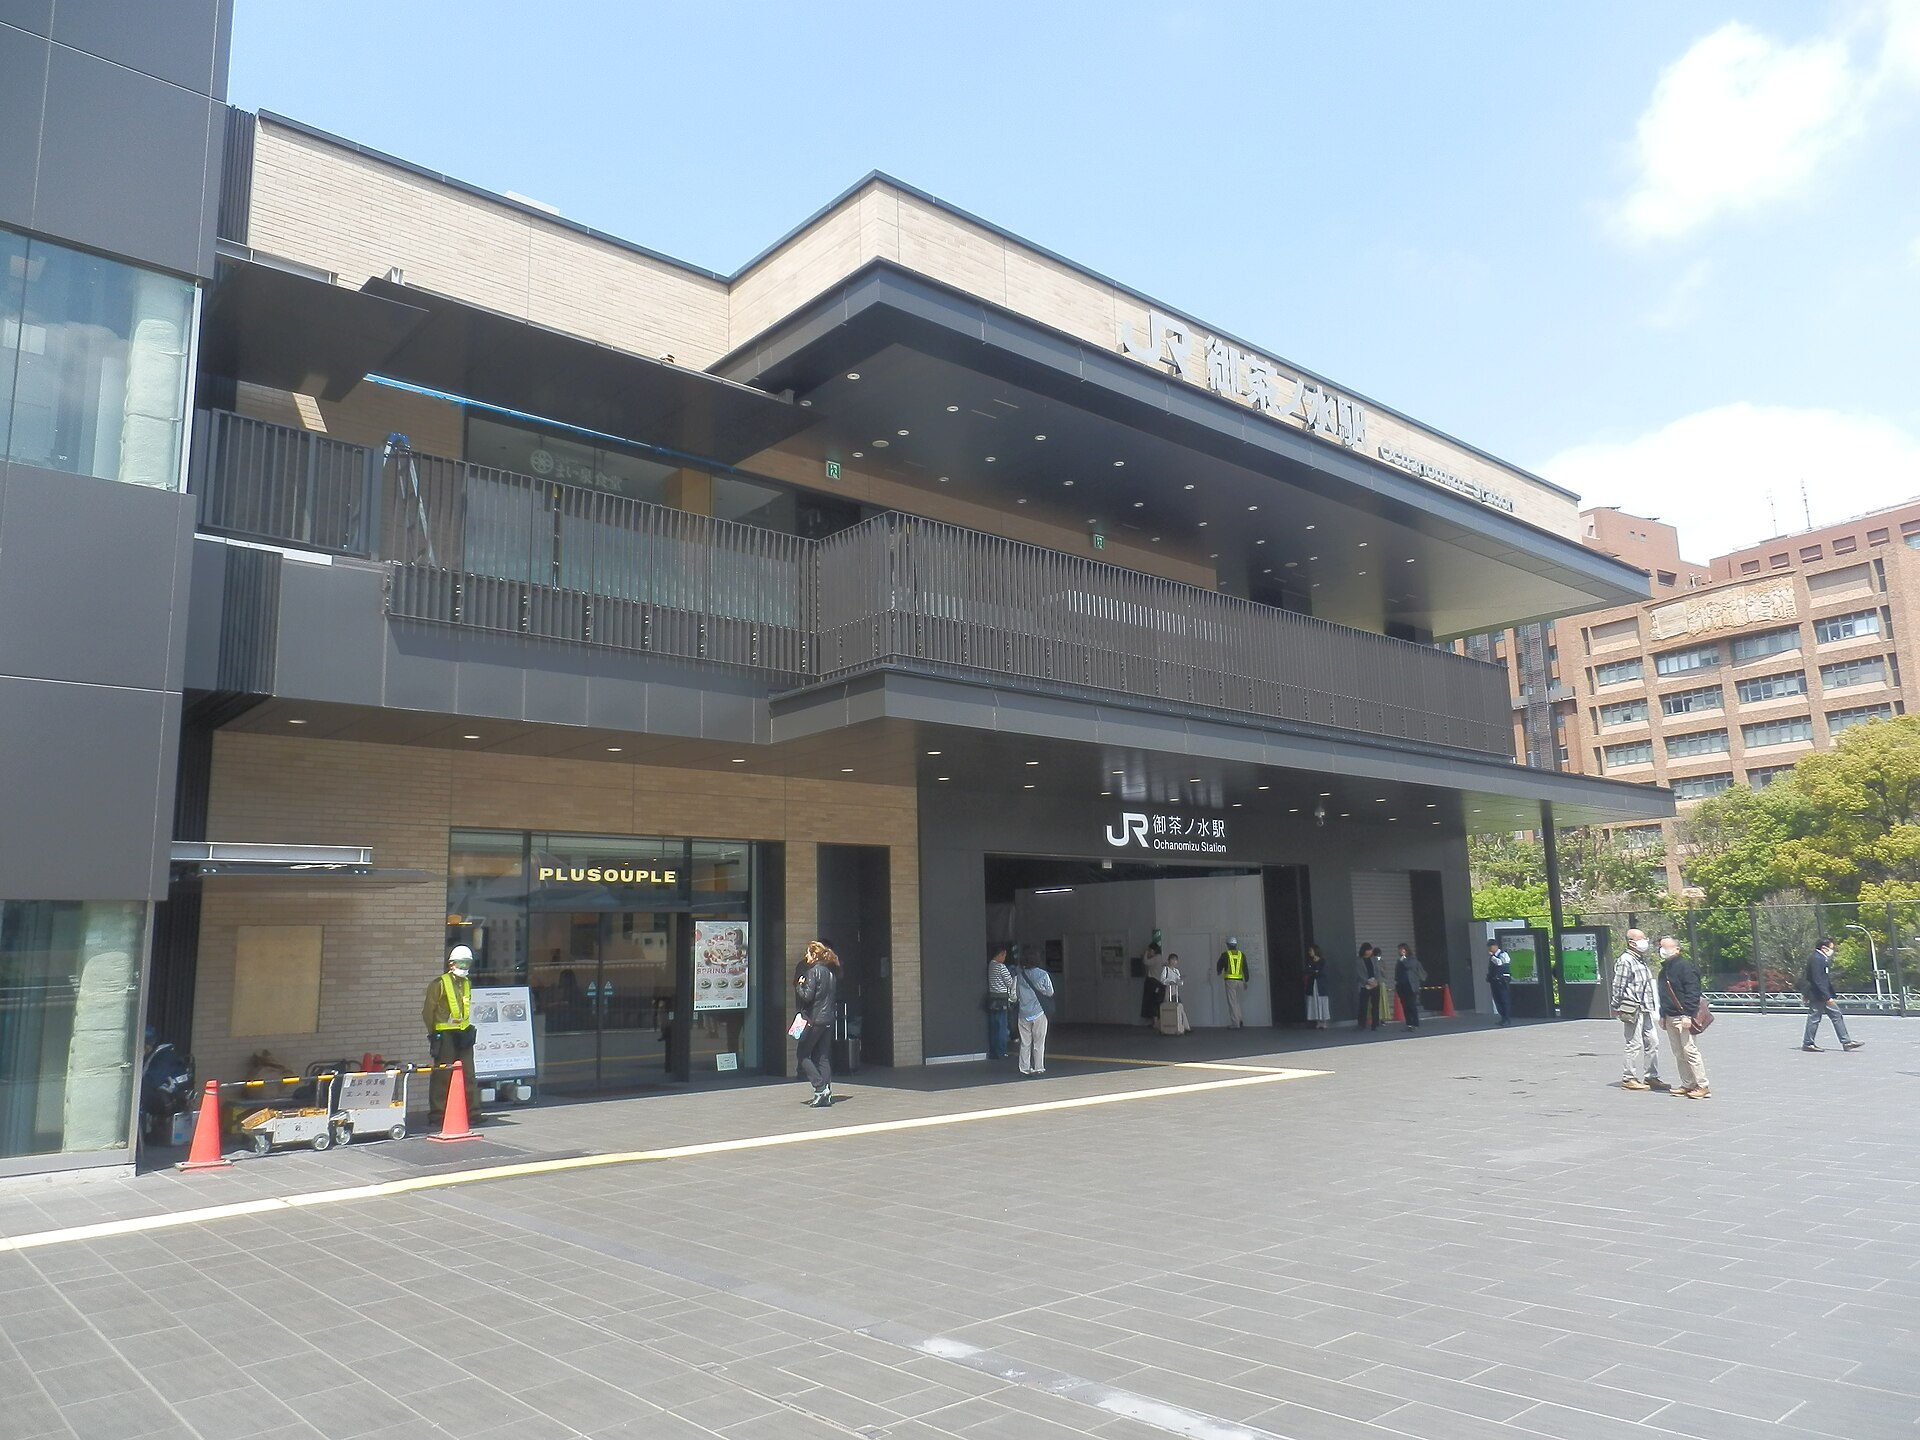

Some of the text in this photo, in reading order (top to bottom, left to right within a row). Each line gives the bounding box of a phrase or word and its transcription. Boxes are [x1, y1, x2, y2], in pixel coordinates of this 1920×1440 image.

[1122, 309, 1367, 452] JR 御茶ノ水駅
[1105, 812, 1226, 849] JR 御茶ノ水駅
[1153, 838, 1227, 853] Ochanomizu Station
[539, 867, 676, 883] PLUSOUPLE
